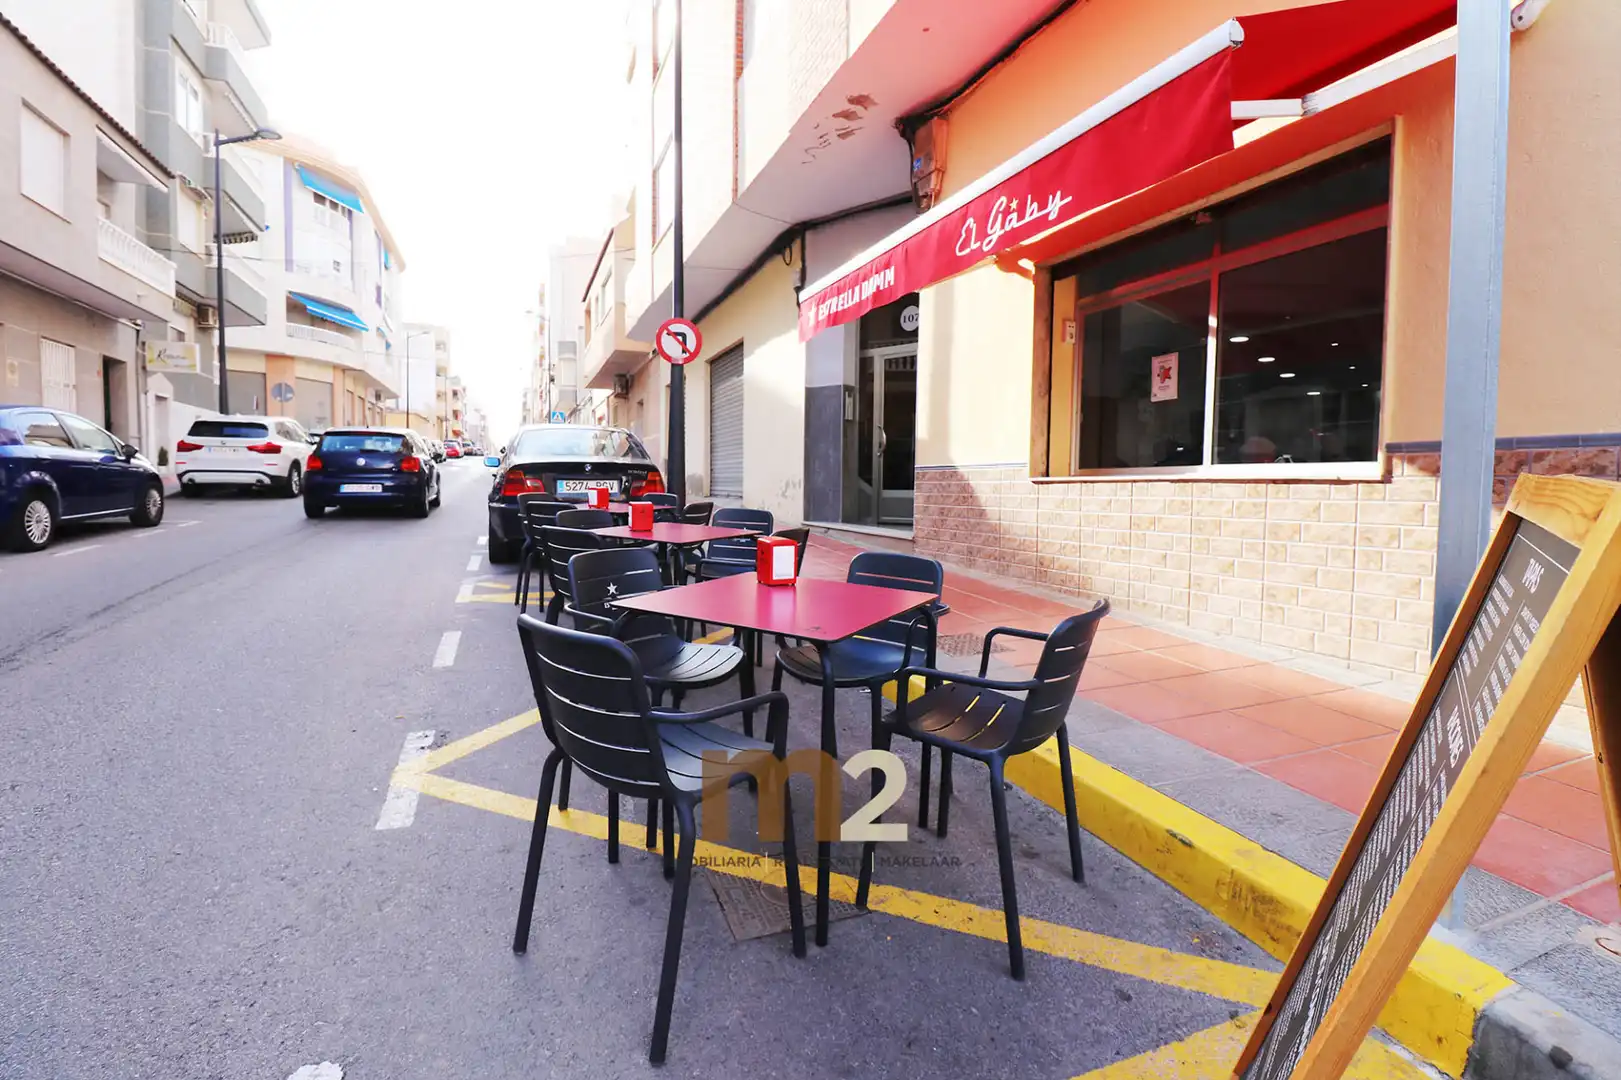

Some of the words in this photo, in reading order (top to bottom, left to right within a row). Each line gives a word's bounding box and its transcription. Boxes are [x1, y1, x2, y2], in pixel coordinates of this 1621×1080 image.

[818, 284, 860, 321] ESTRELLA
[860, 265, 896, 301] DAMM
[565, 481, 591, 491] 5274
